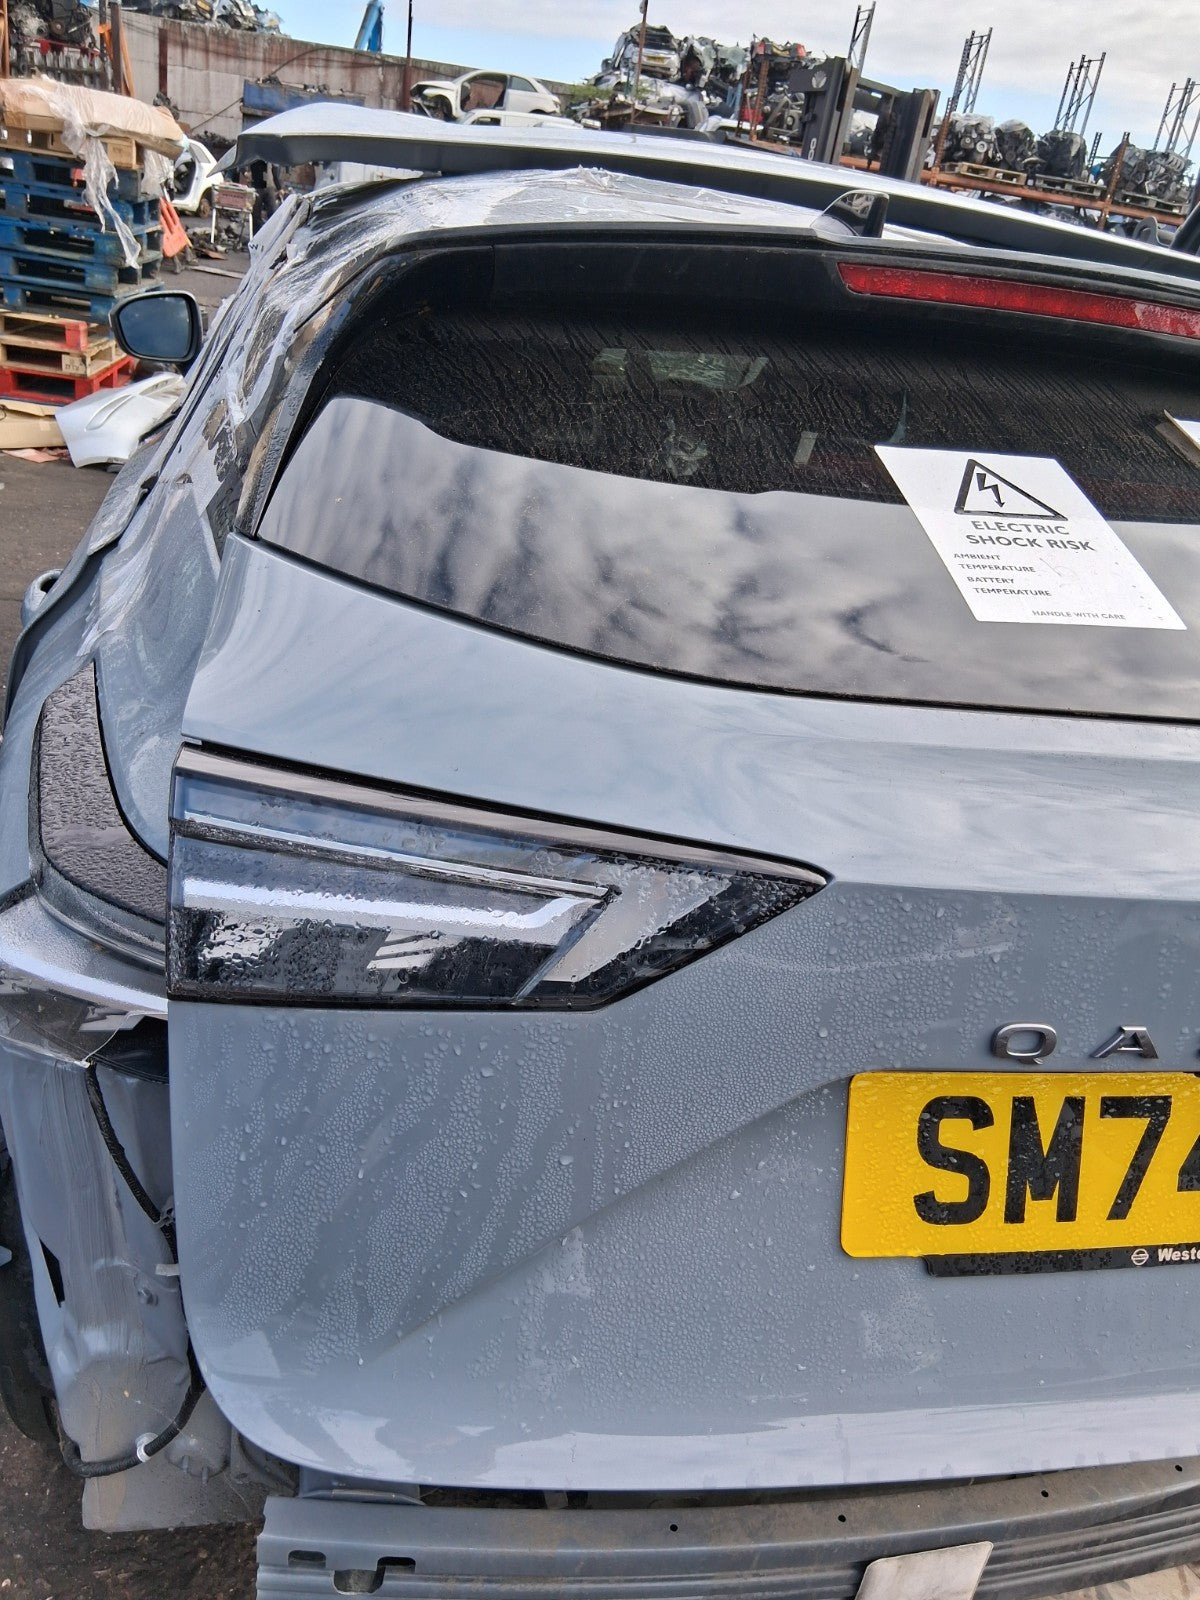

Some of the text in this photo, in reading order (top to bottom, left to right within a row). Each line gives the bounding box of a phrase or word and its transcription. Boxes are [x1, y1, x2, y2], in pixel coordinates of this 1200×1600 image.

[971, 520, 1070, 536] ELECTRIC
[966, 534, 1096, 552] SHOCK RISK
[954, 553, 1001, 561] AMBIENT
[958, 563, 1036, 573] TEMPERATURE
[967, 576, 1014, 584] BATTERY
[974, 587, 1052, 597] TEMPERATURE
[992, 1023, 1200, 1064] QA
